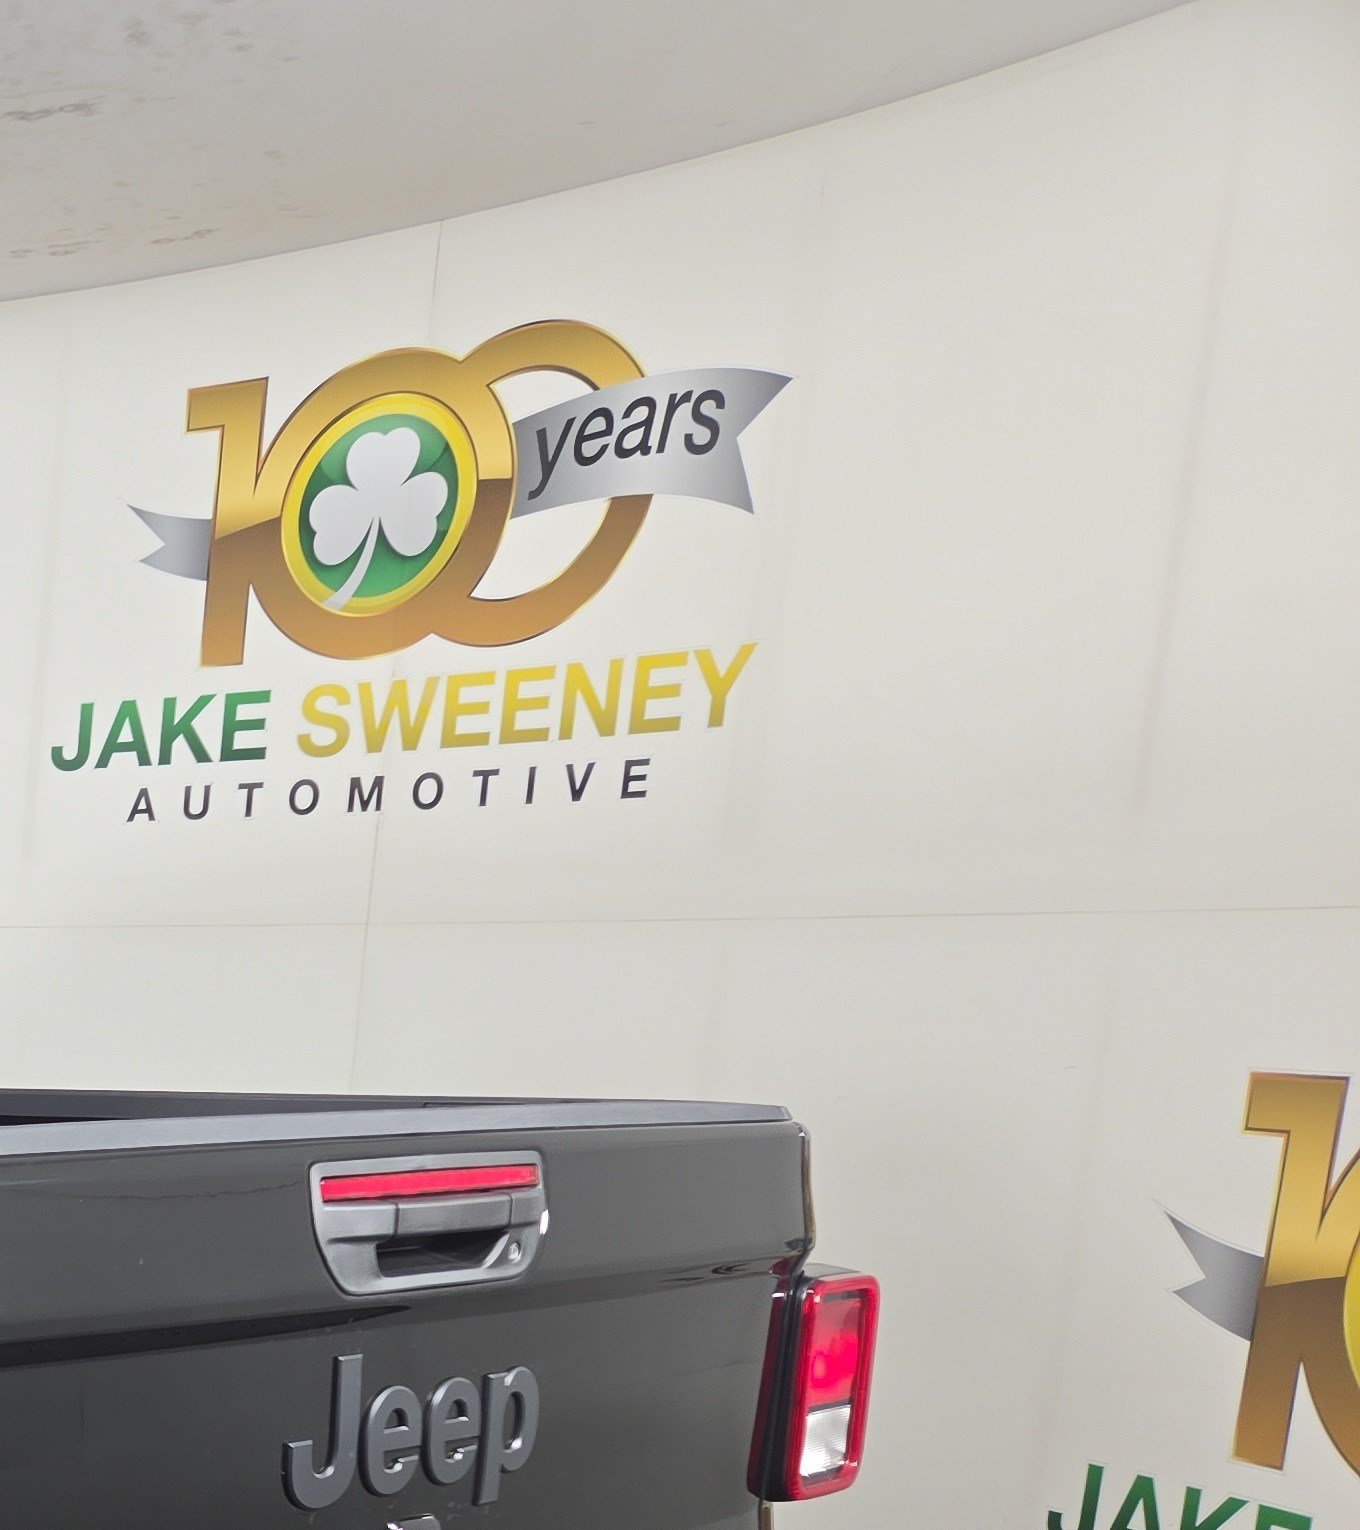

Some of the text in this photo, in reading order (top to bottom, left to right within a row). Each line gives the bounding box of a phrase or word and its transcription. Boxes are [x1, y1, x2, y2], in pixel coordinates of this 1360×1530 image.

[185, 318, 654, 668] 100
[526, 386, 726, 502] years
[50, 642, 758, 773] JAKE SWEENEY
[126, 758, 652, 824] AUTOMOTIVE
[281, 1353, 541, 1510] Jeep
